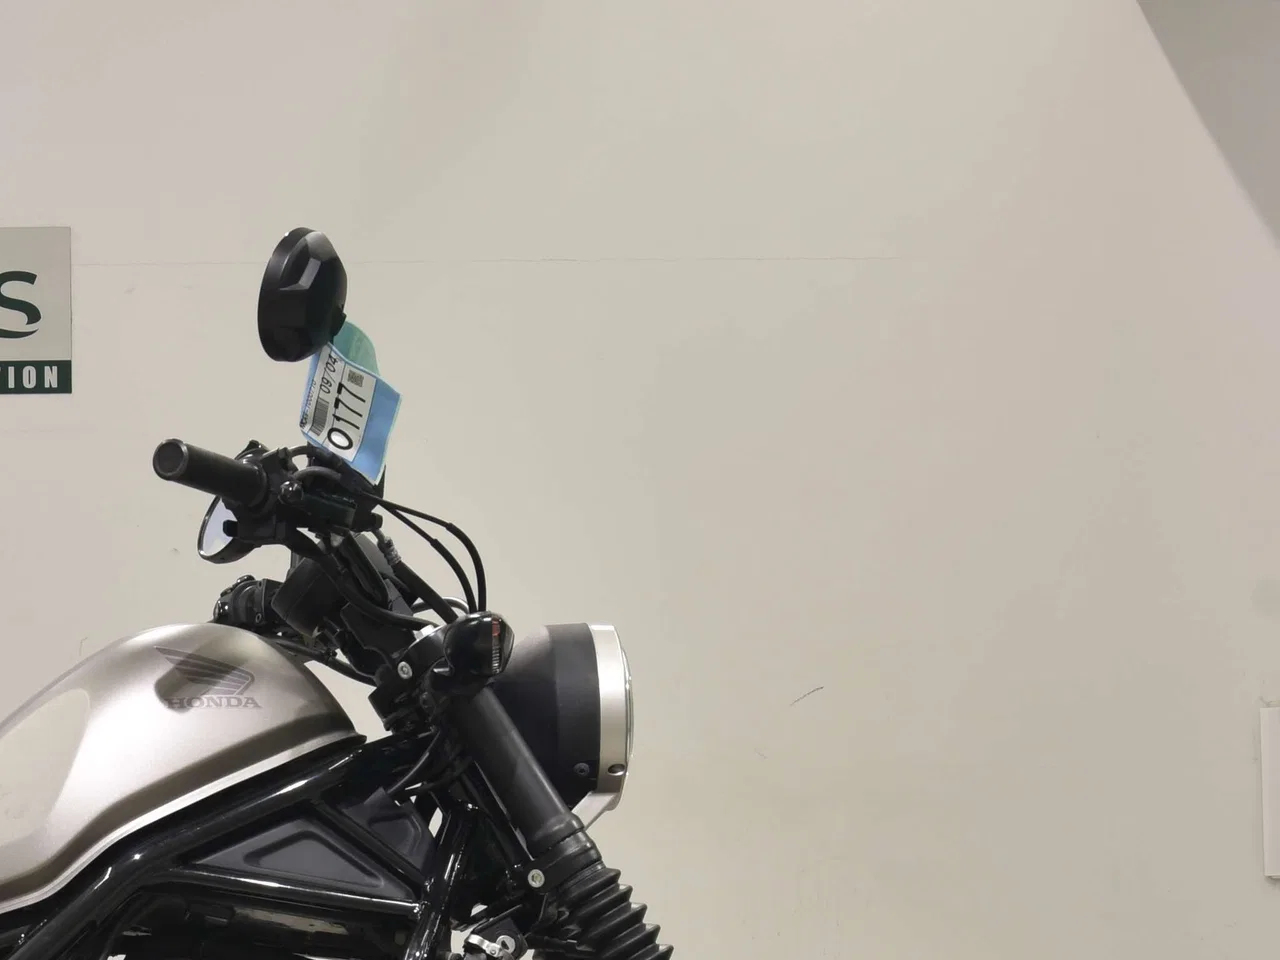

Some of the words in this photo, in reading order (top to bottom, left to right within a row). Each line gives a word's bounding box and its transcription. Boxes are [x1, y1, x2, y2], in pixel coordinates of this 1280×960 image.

[320, 354, 338, 394] 09/04
[327, 382, 366, 450] 0177
[165, 696, 263, 709] HONDA
